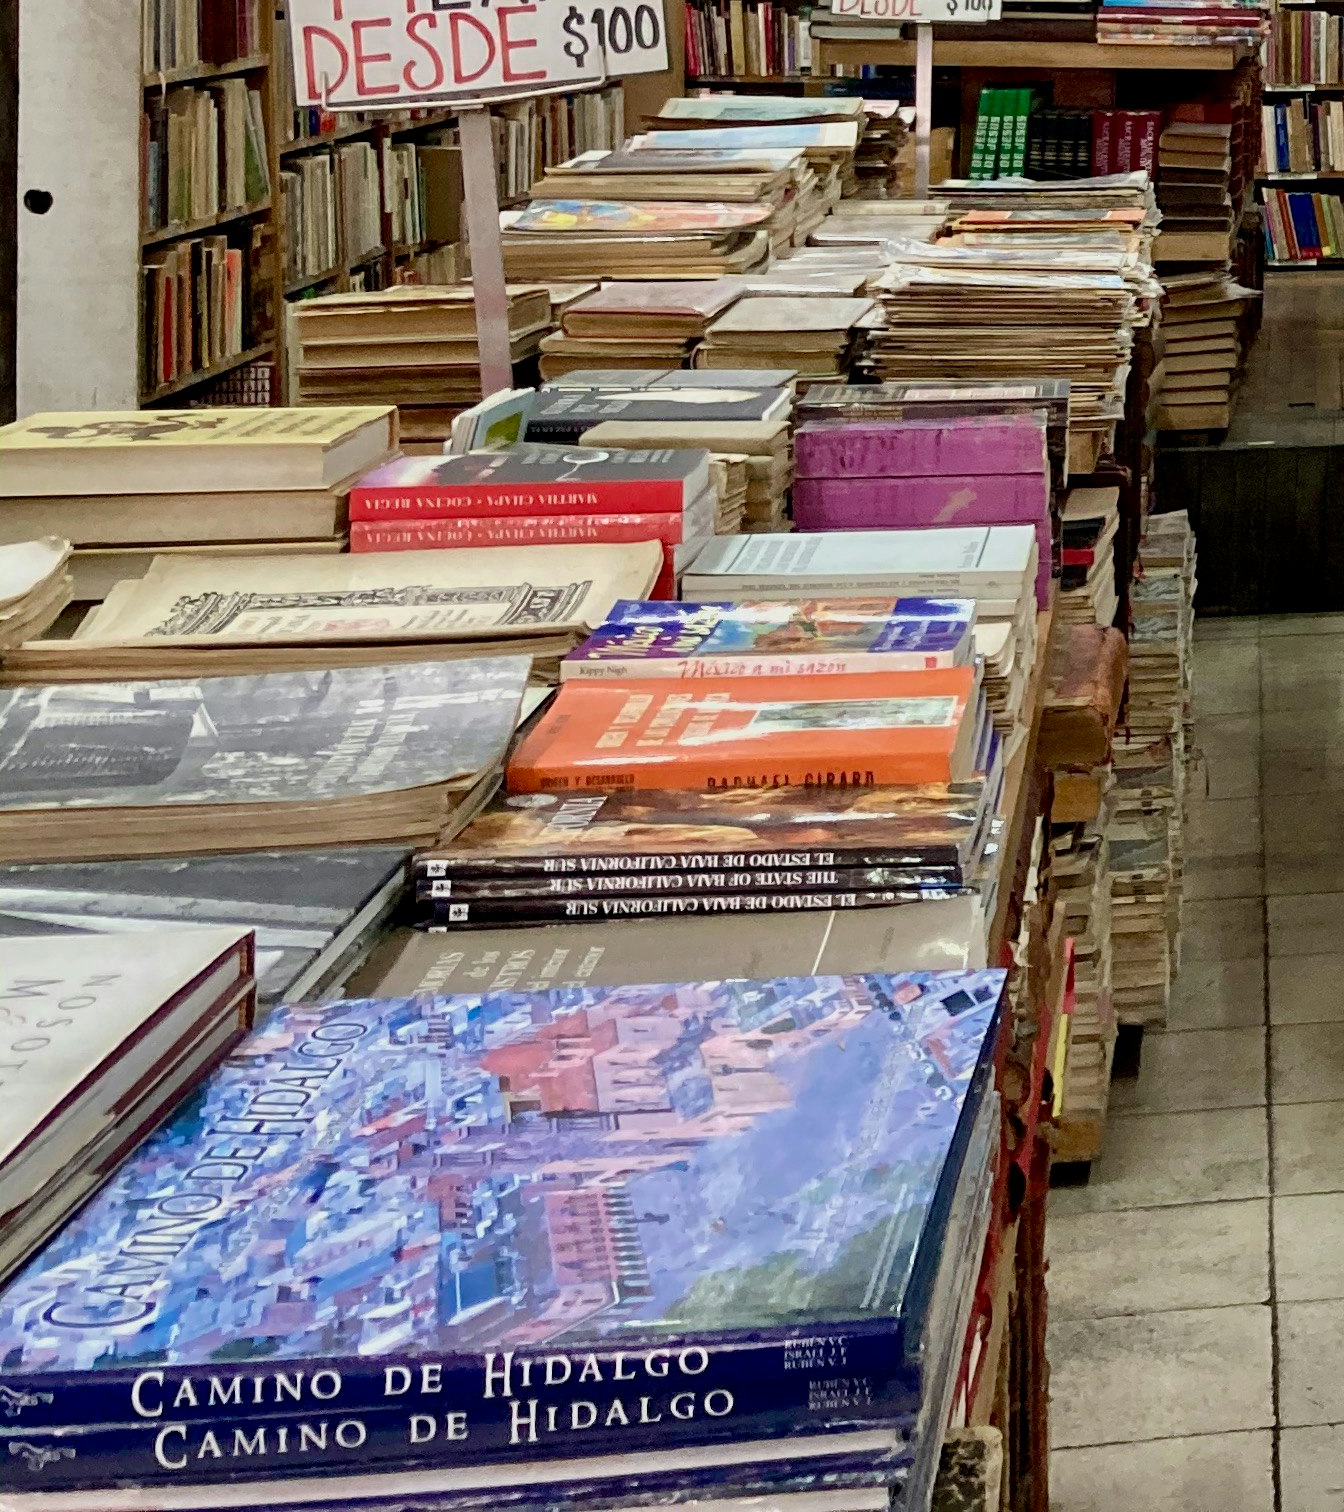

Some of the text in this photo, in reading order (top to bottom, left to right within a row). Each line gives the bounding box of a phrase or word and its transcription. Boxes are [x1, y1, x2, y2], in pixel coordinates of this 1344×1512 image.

[302, 3, 661, 100] DESDE $100
[544, 853, 834, 872] EL ESTADO DE BAJA CALIFORNIA SUR
[549, 871, 838, 891] THE STATE OF BAJA CALIFORNIA SUR
[565, 893, 857, 916] EL ESTADO DE BAJA CALIFORNIA SUR
[131, 1346, 710, 1418] CAMINO DE HIDALGO
[154, 1388, 735, 1470] CAMINO DE HIDALGO
